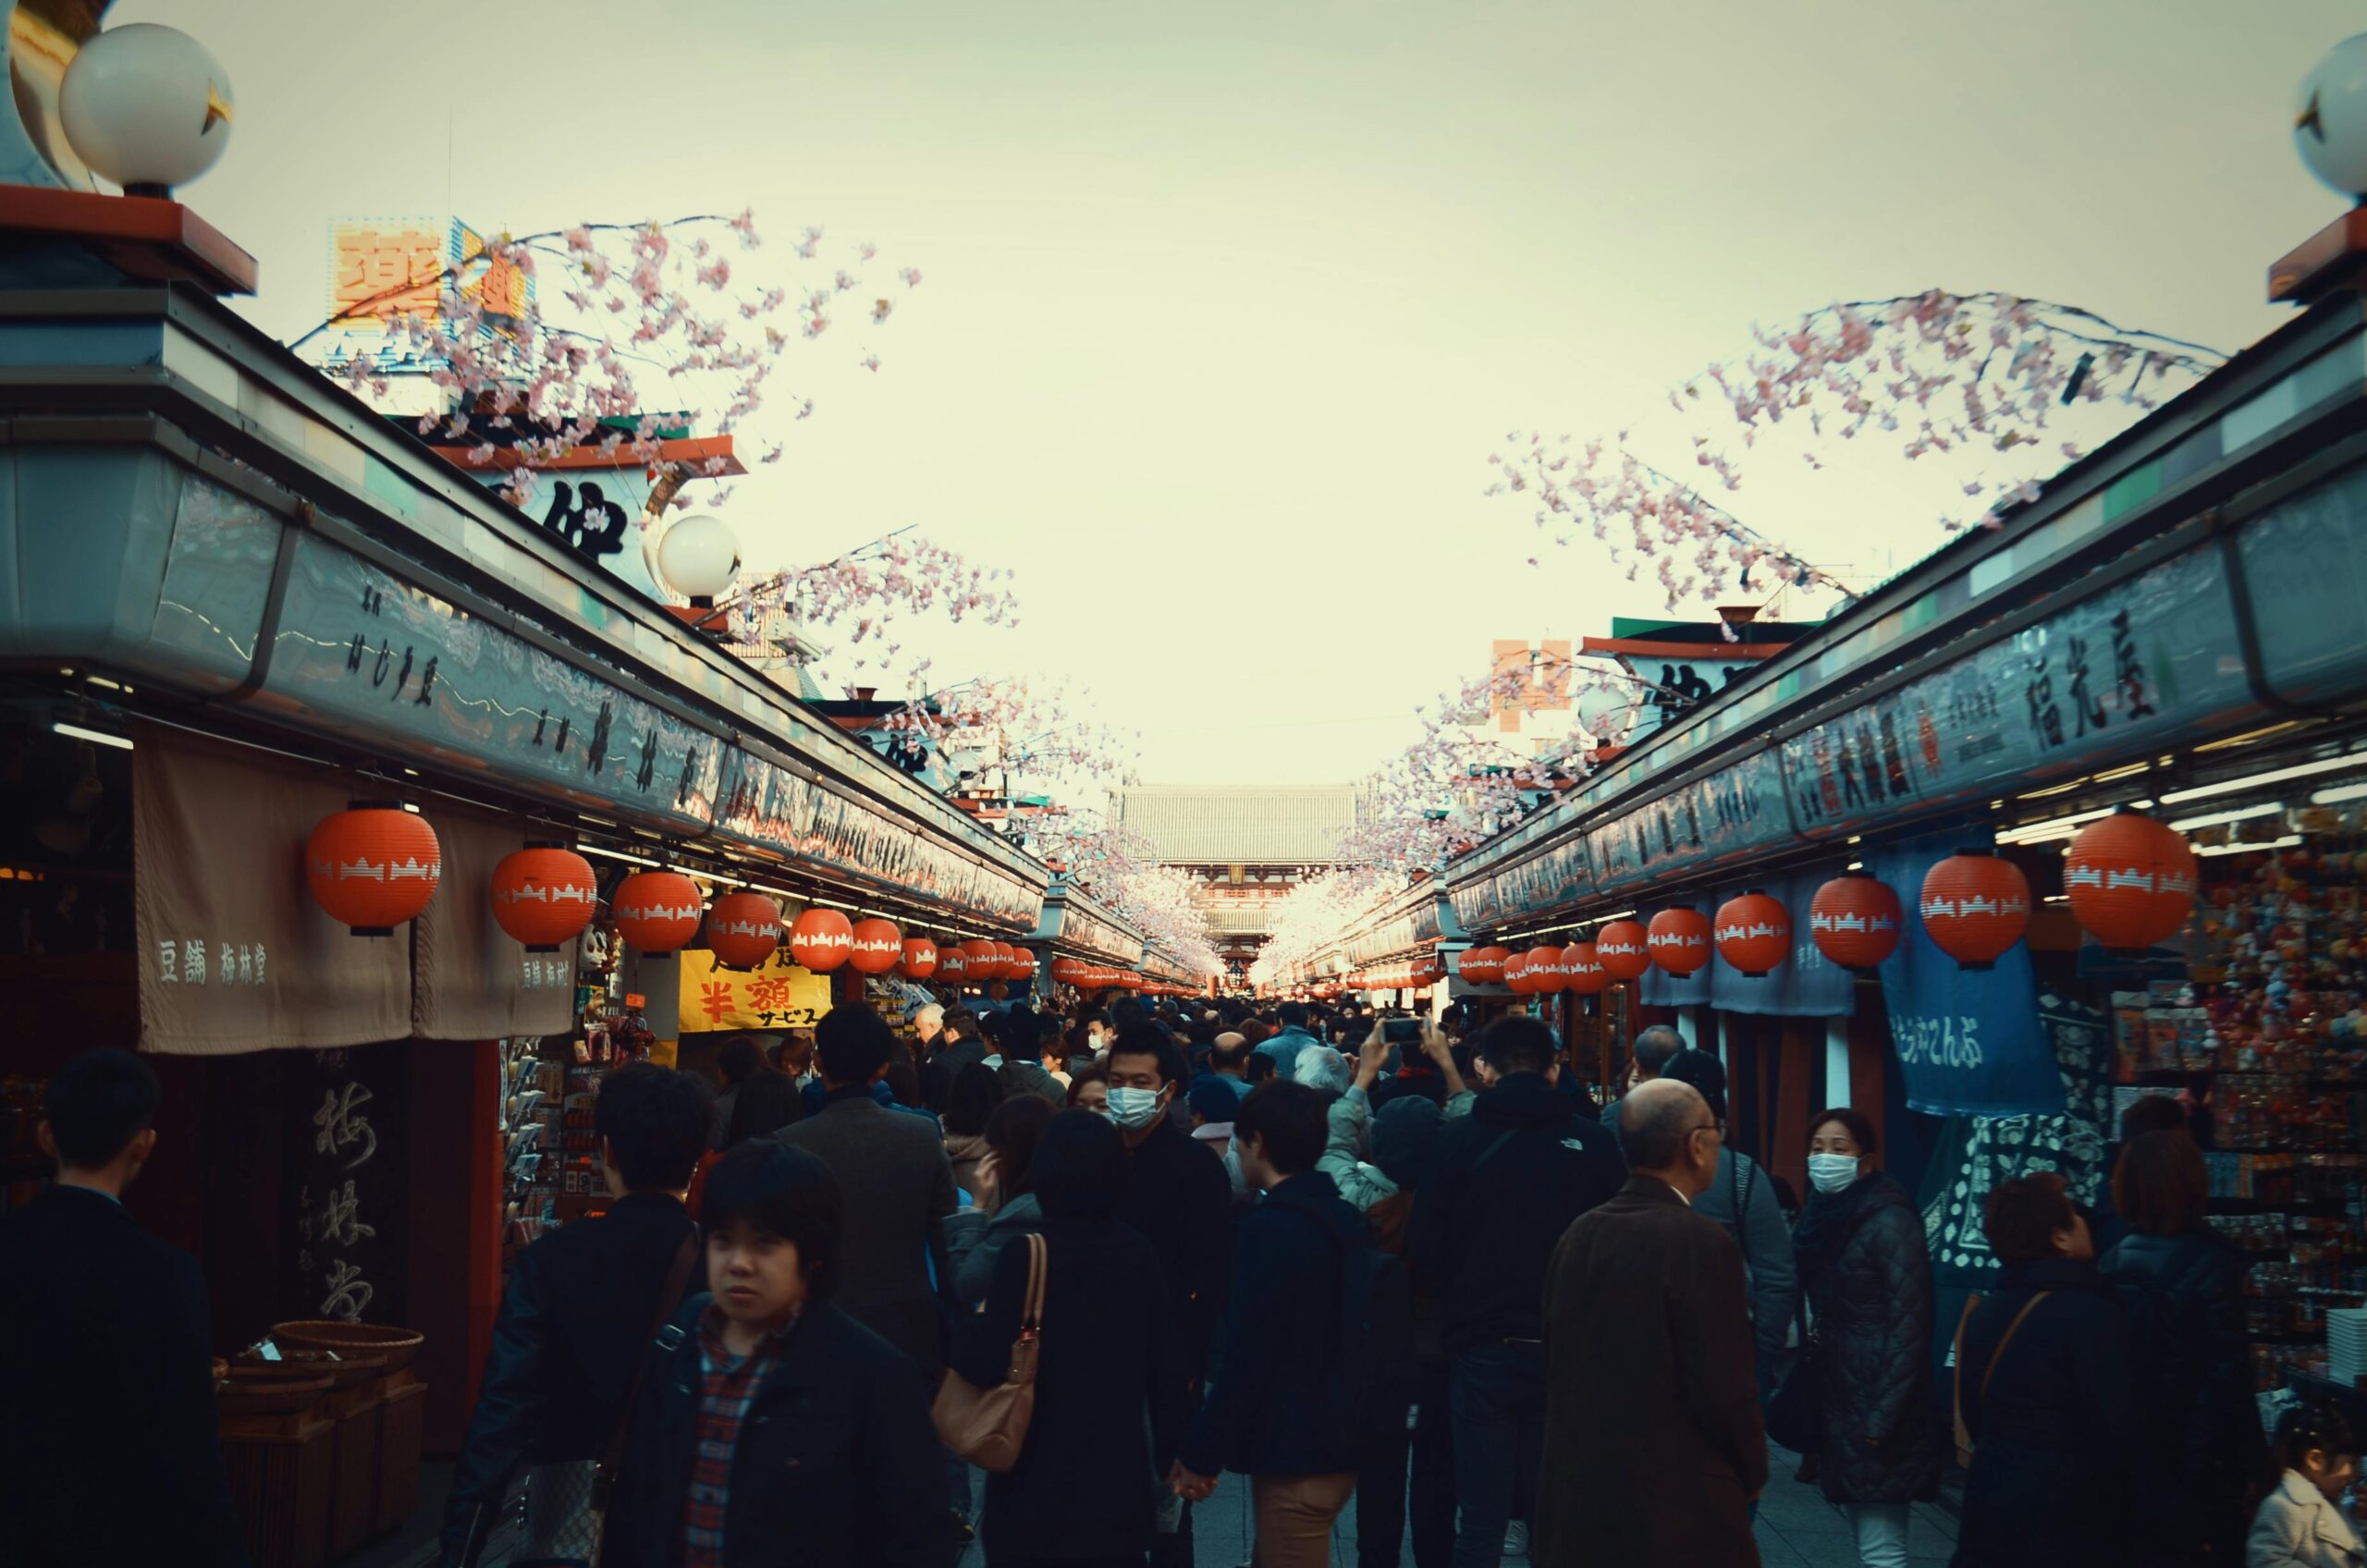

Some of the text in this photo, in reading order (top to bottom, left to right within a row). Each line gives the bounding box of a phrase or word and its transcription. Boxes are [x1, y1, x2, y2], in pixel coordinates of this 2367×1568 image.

[220, 941, 266, 986] 梅林堂
[700, 974, 794, 1023] 半額
[756, 1008, 820, 1026] サービス
